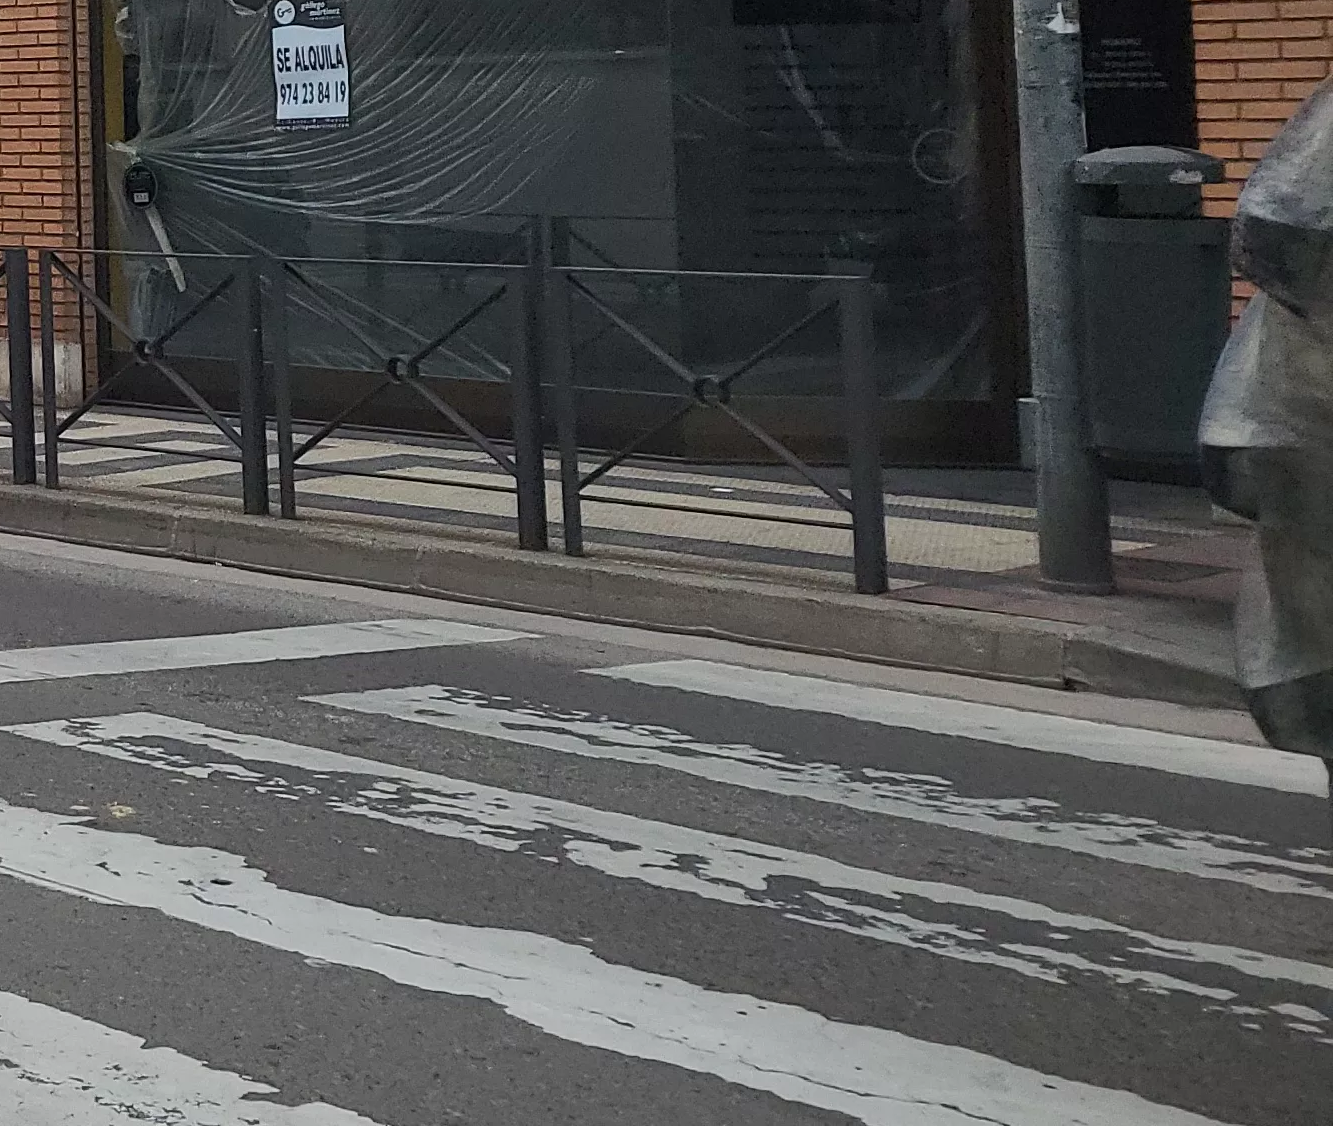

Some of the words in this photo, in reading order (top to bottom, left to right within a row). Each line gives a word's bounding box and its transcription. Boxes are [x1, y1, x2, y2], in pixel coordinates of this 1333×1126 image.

[276, 47, 292, 73] SE
[295, 43, 345, 72] ALQUILA
[280, 82, 299, 105] 974
[302, 82, 314, 104] 23
[317, 81, 331, 104] 84
[335, 80, 347, 103] 19
